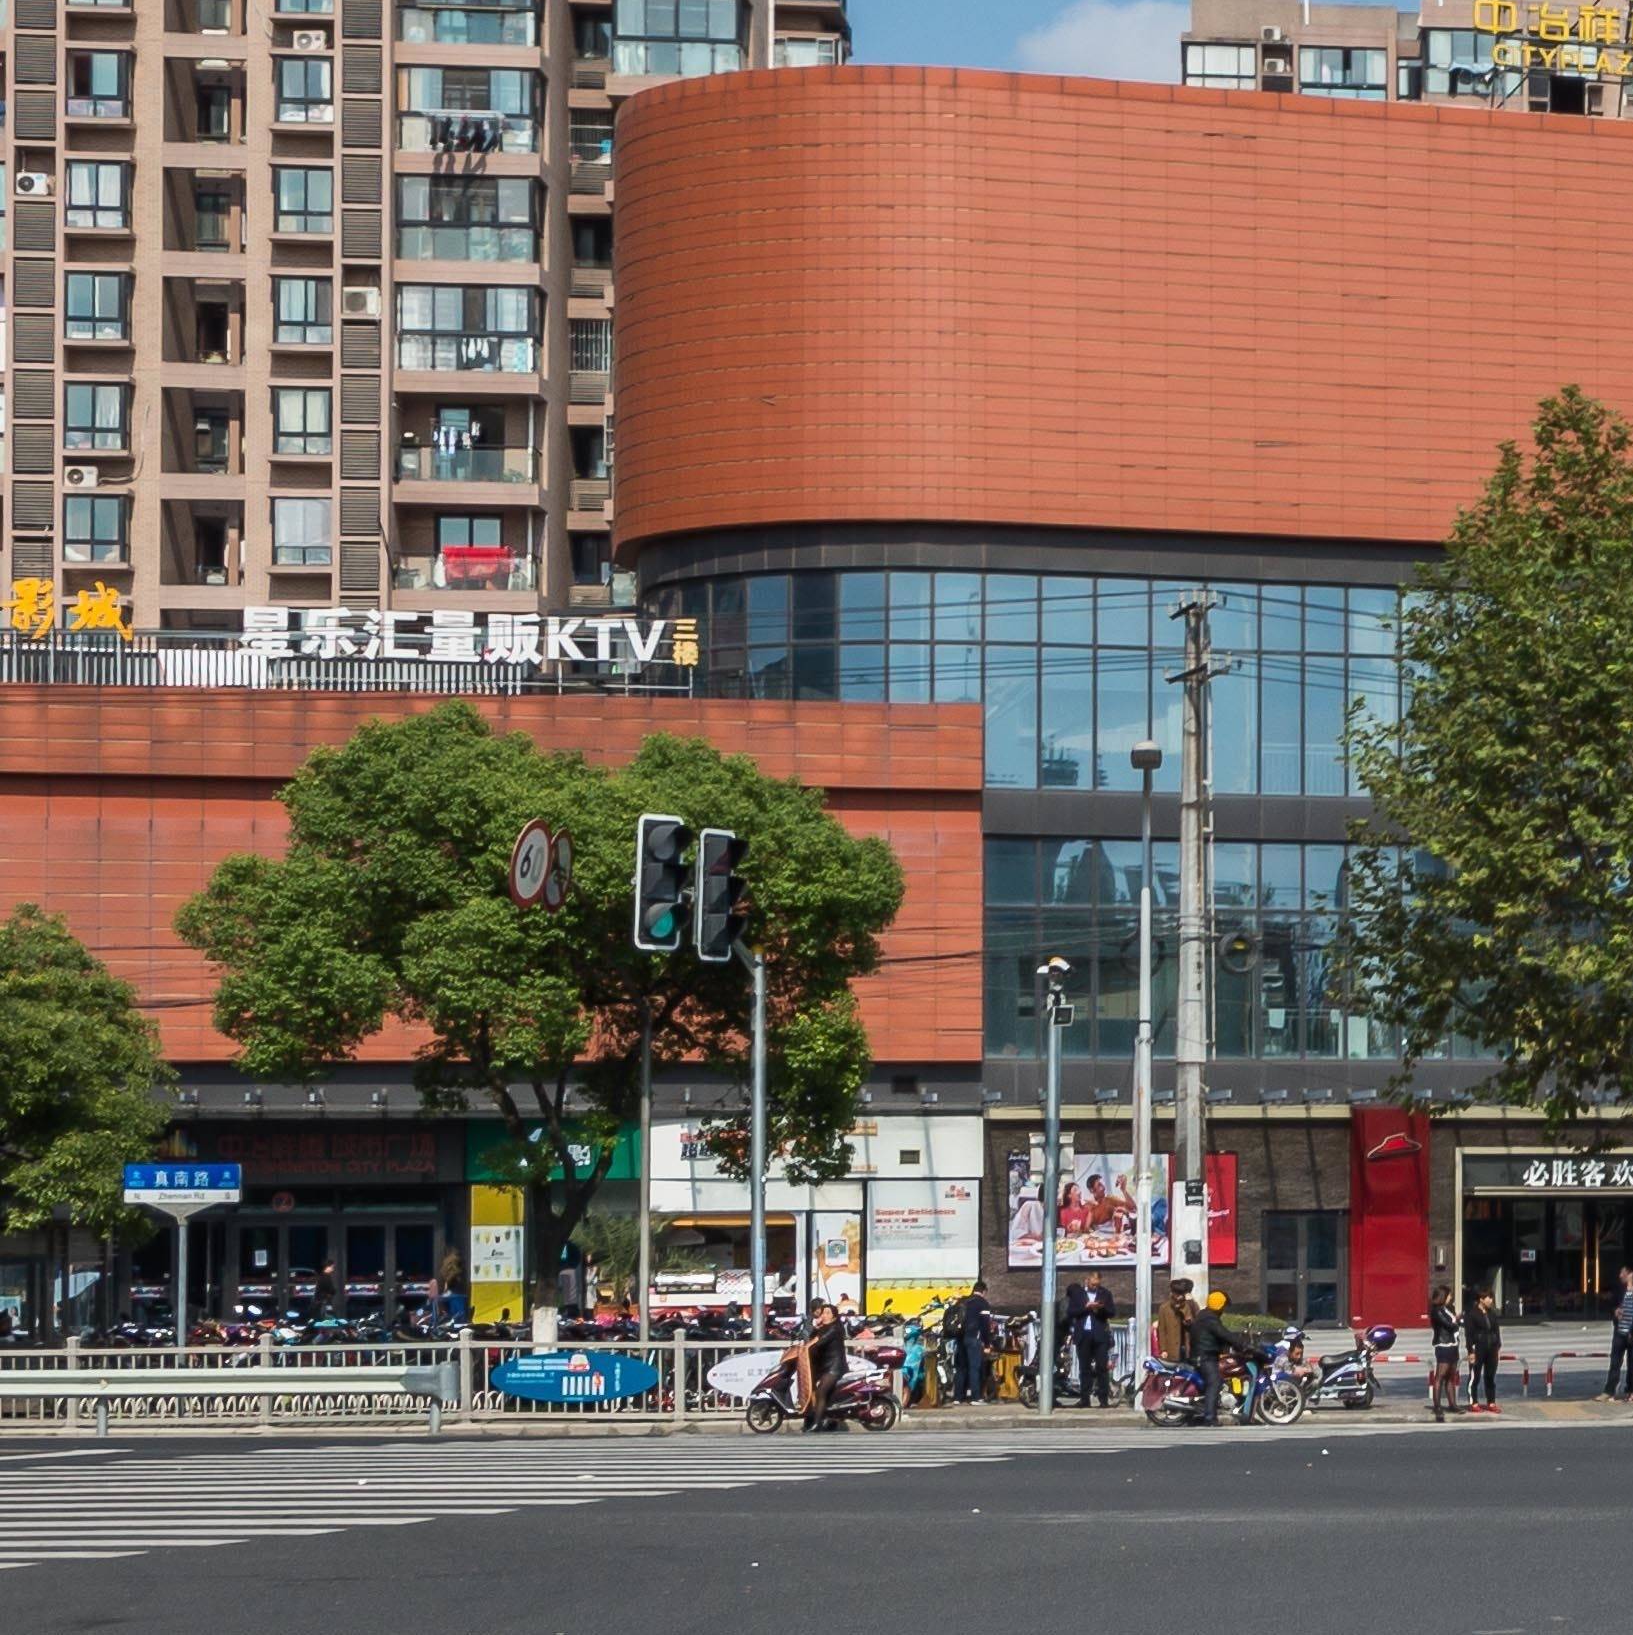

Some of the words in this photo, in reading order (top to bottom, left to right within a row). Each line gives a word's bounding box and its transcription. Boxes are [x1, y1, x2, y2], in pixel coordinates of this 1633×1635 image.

[1, 577, 133, 641] 影城
[240, 606, 666, 665] 星乐汇量贩KTV
[154, 1170, 209, 1188] 真南路
